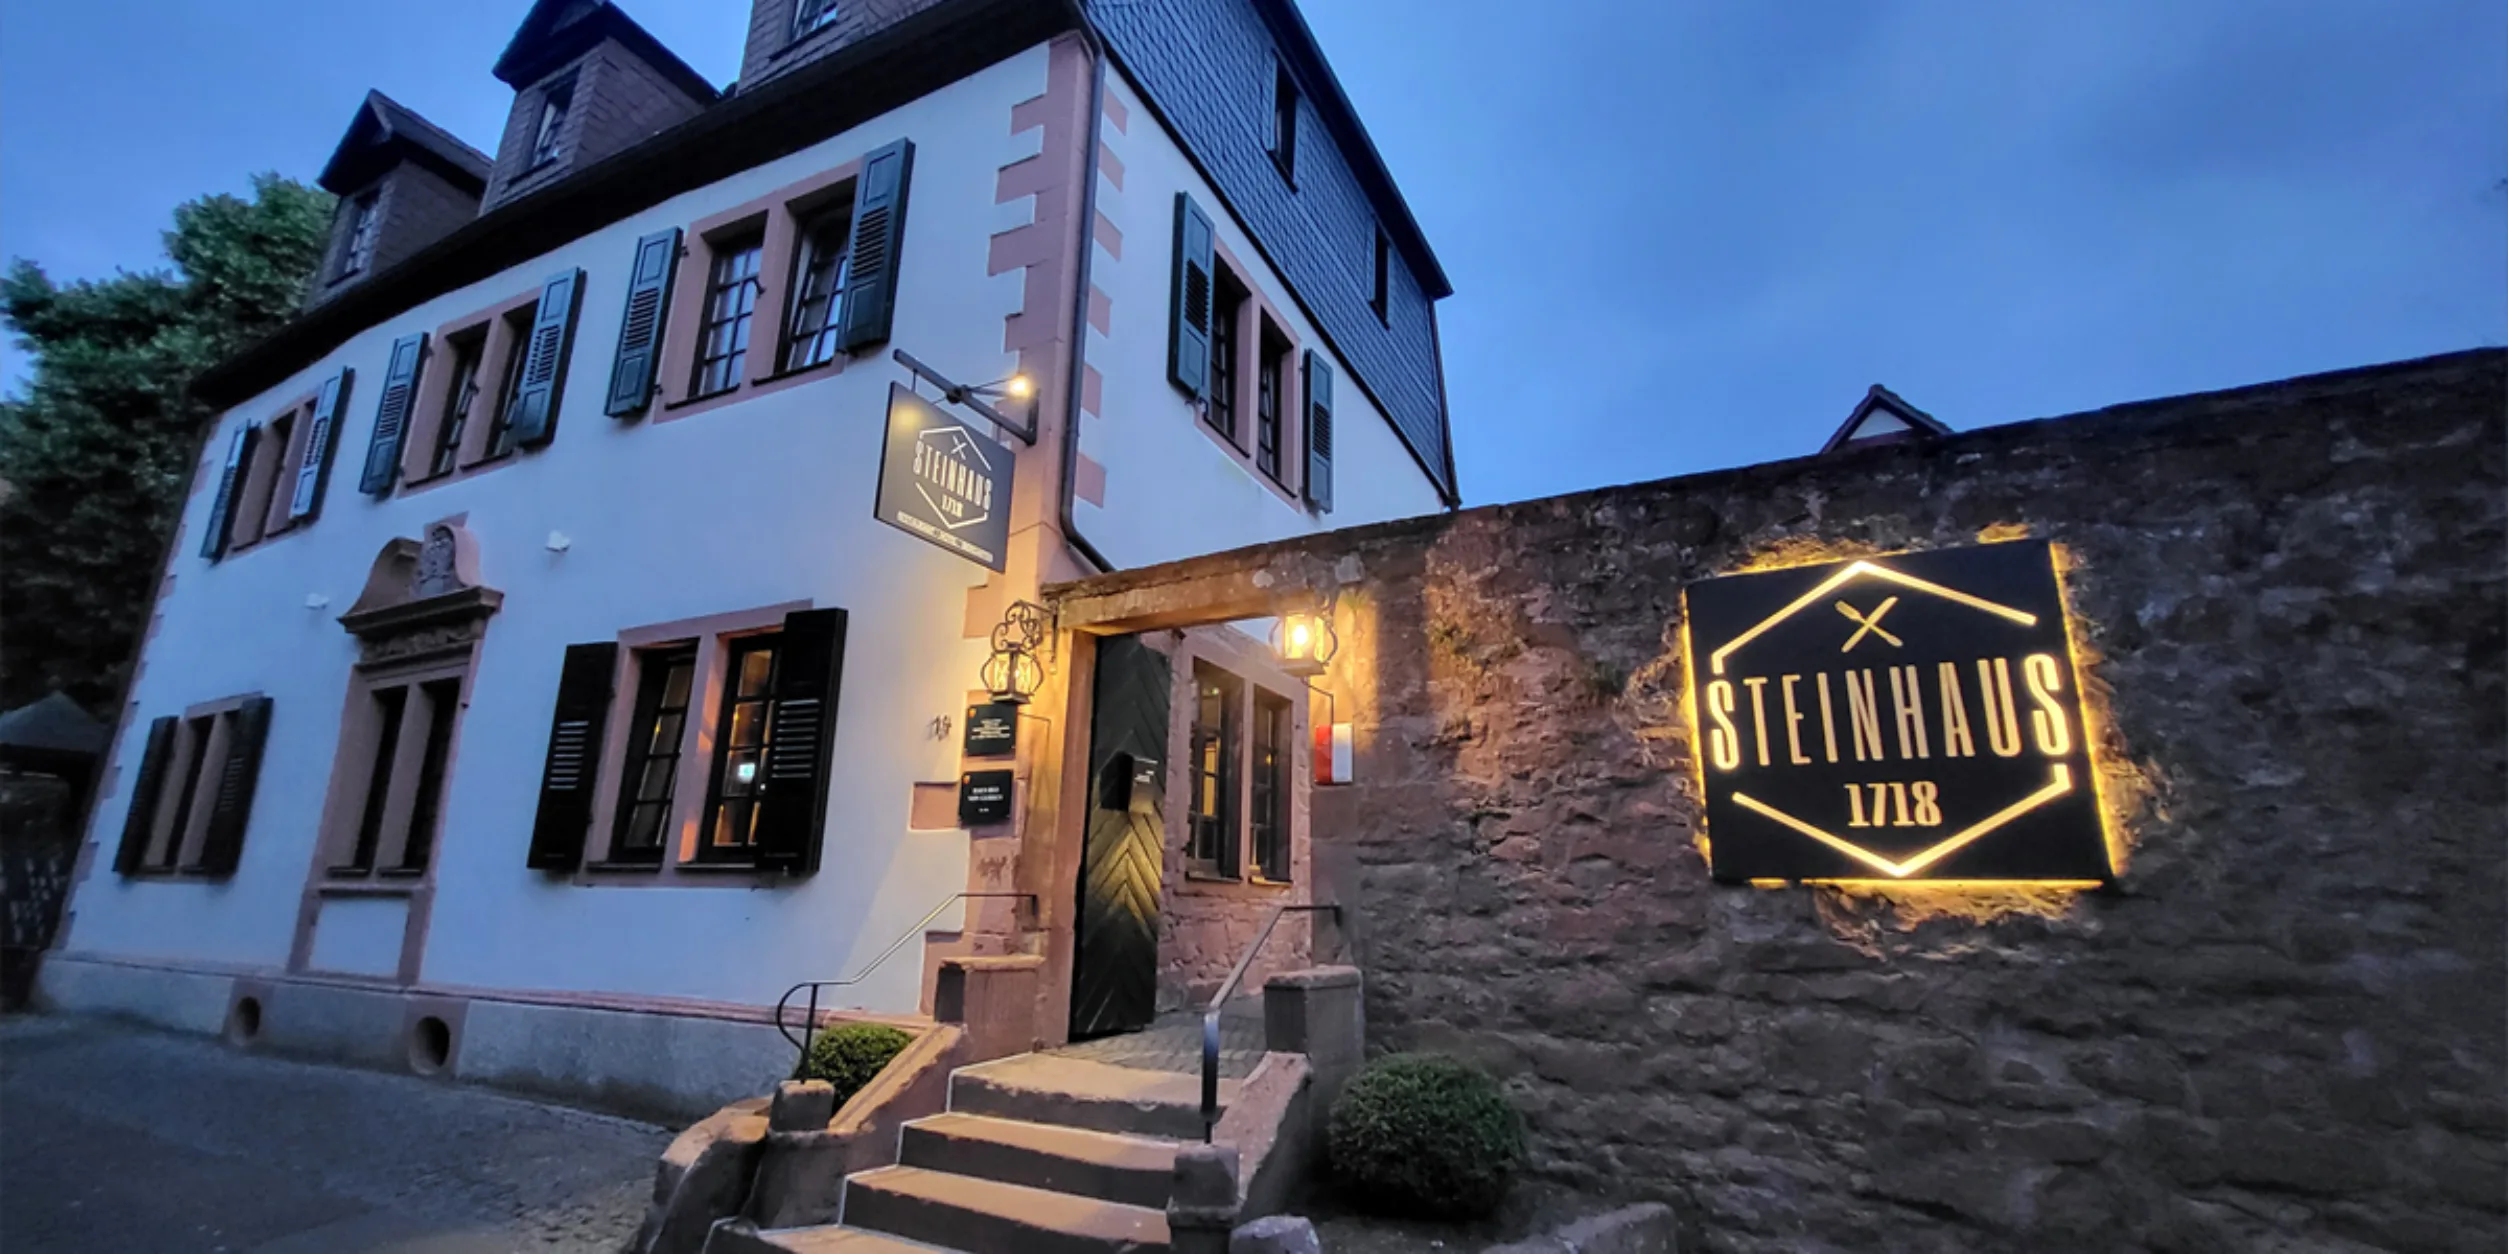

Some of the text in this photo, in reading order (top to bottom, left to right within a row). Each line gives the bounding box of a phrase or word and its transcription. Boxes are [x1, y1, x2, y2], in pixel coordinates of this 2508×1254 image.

[912, 440, 993, 511] STEINHAUS
[1707, 652, 2071, 770] STEINHAUS
[1844, 780, 1942, 827] 1718
